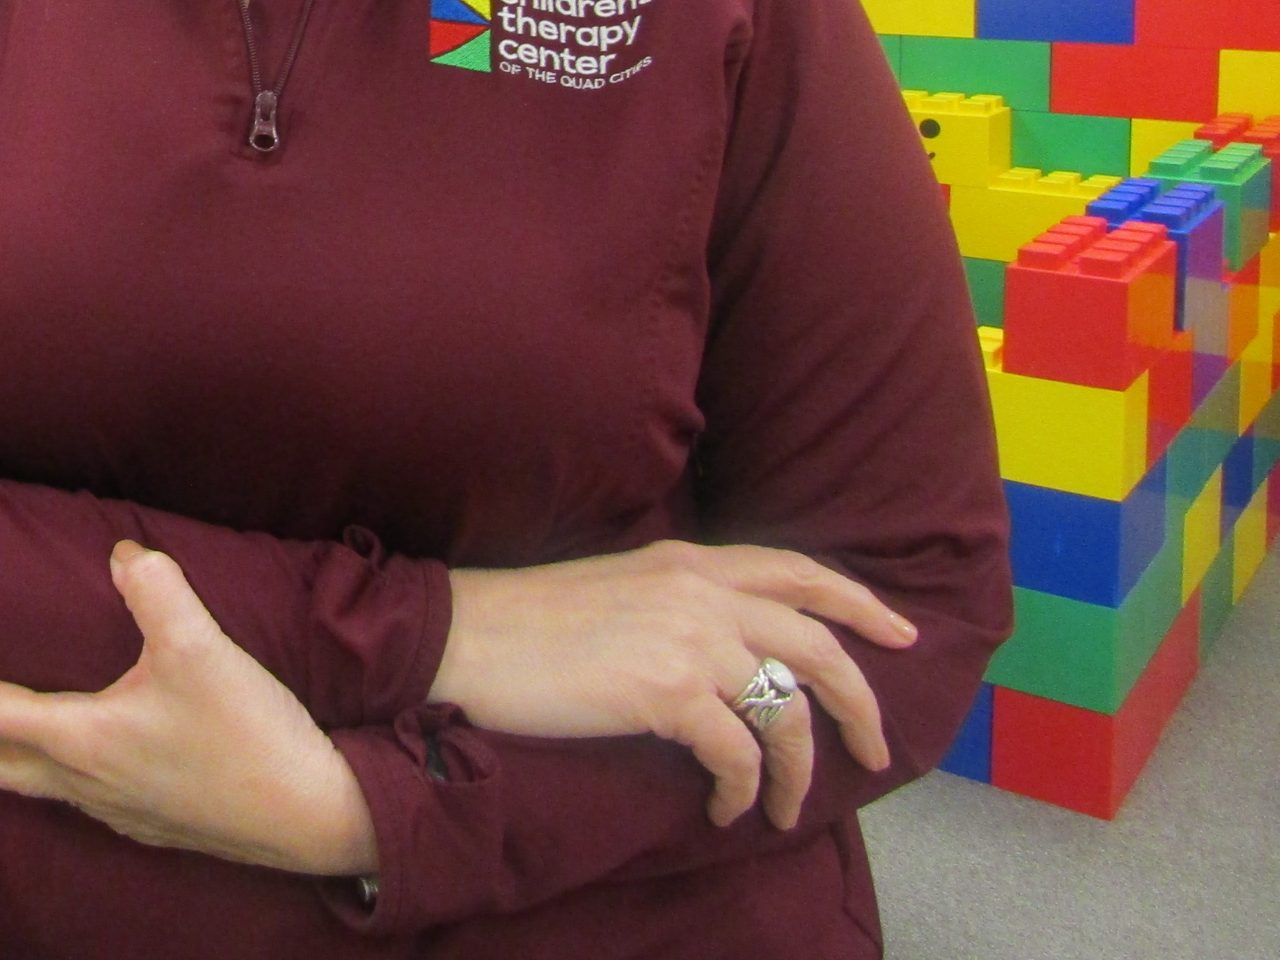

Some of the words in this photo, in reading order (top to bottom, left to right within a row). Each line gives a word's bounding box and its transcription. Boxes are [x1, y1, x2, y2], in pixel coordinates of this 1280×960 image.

[497, 6, 641, 51] therapy
[498, 39, 616, 75] center
[499, 61, 521, 75] OF
[526, 66, 557, 83] THE
[560, 75, 606, 89] QUAD
[609, 56, 652, 83] CITIES
